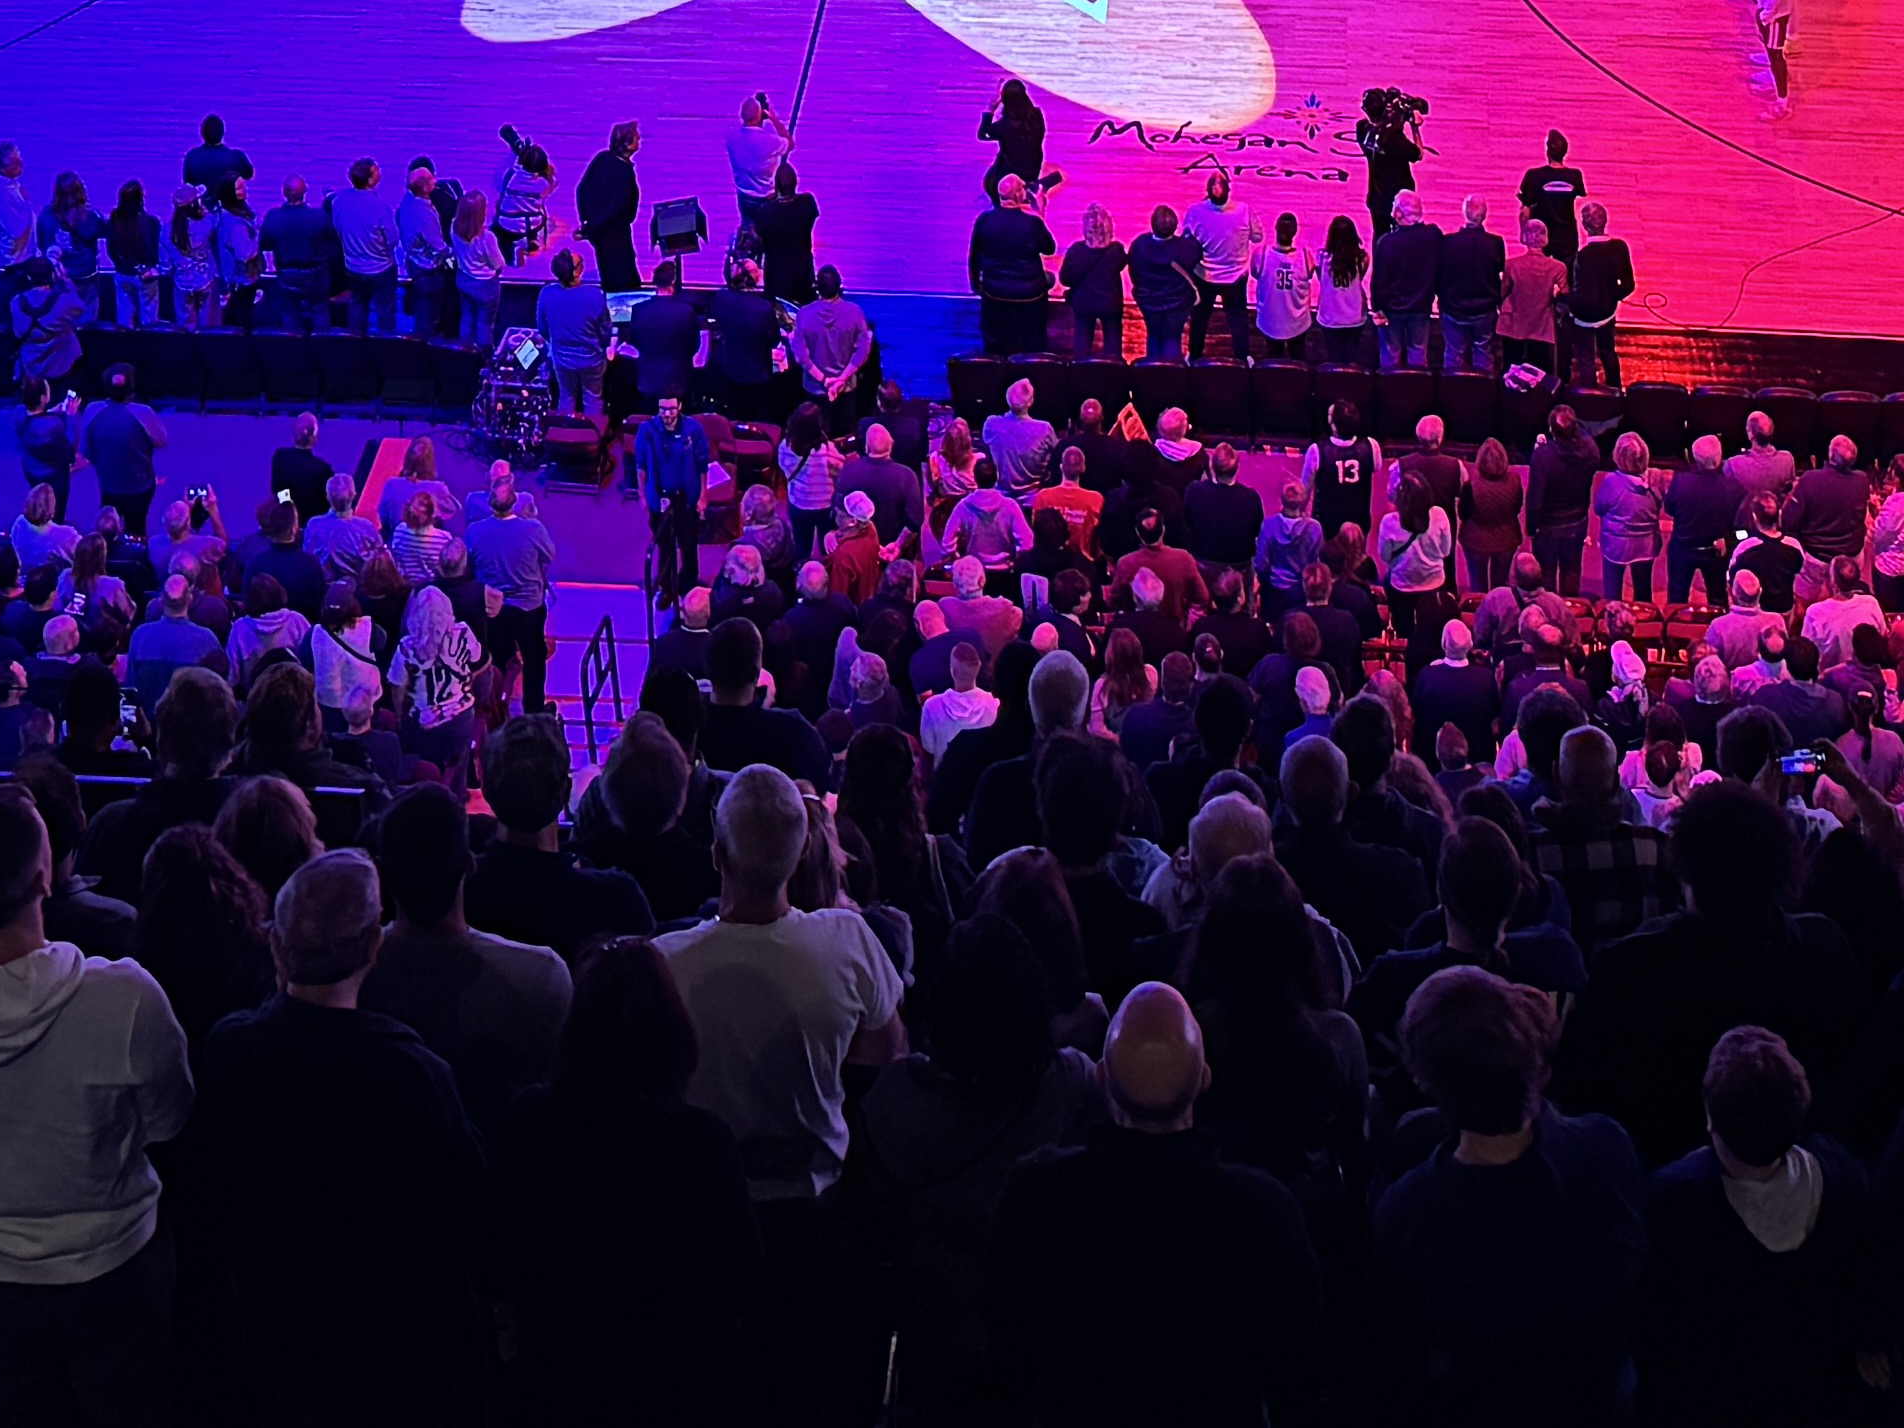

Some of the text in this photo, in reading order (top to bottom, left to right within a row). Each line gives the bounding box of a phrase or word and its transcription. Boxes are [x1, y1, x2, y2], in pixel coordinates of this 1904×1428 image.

[1087, 120, 1319, 154] Mohegan
[1176, 152, 1350, 184] Arena
[1277, 270, 1293, 290] 35
[1336, 459, 1359, 484] 13
